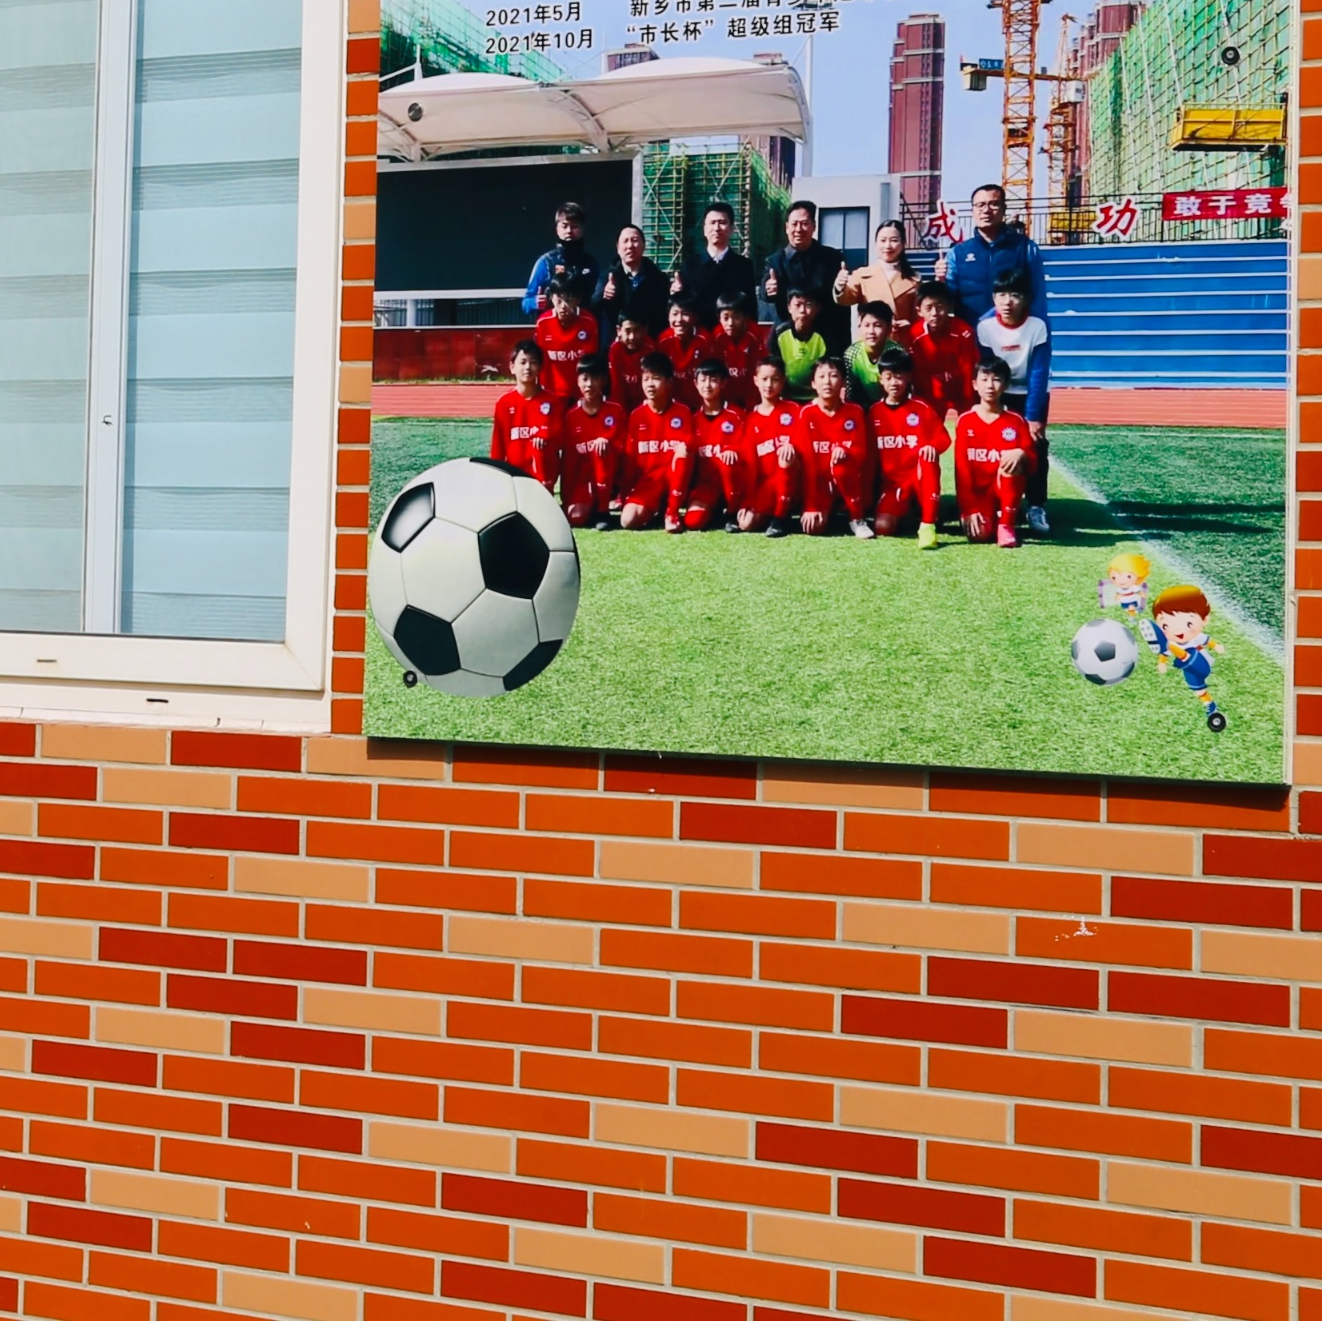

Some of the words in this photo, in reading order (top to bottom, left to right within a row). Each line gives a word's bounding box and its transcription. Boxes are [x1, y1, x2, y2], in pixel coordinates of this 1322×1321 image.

[486, 1, 581, 27] 2021年5月
[485, 29, 593, 55] 2021年10月
[925, 199, 963, 243] 成
[1094, 198, 1140, 238] 功
[967, 448, 1005, 463] 新区小
